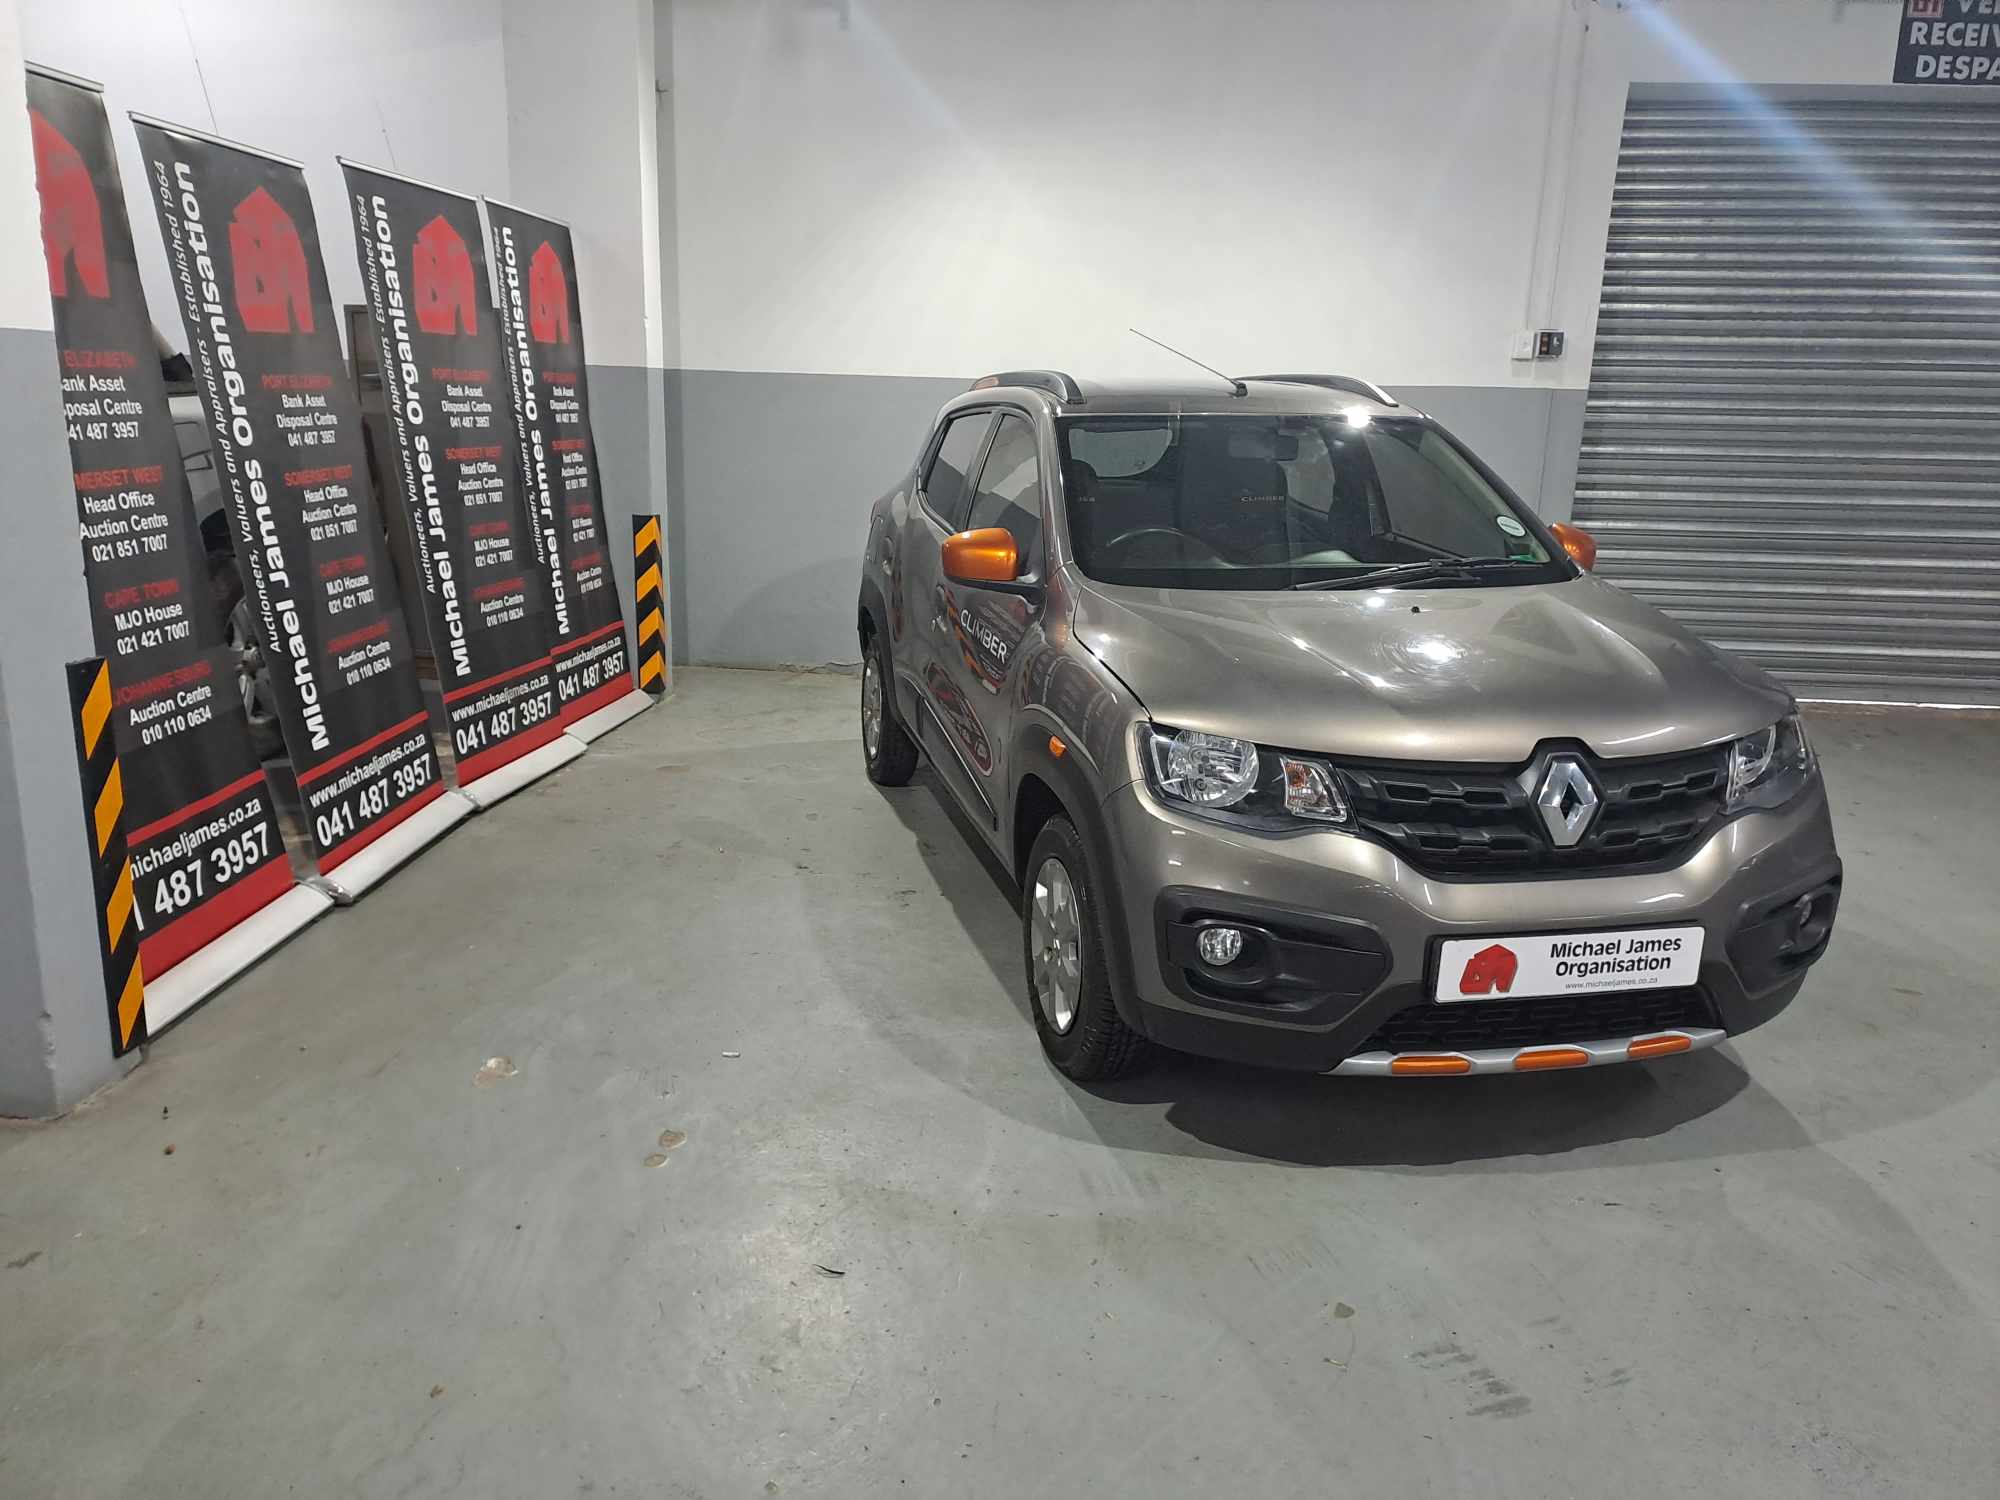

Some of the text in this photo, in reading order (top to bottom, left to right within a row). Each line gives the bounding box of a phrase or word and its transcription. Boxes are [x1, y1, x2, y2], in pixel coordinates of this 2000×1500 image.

[153, 160, 174, 209] 1964
[356, 194, 370, 234] 1964
[165, 213, 200, 323] Established
[362, 236, 385, 324] Established
[61, 375, 126, 391] ank Asset
[197, 338, 228, 435] Appraisers
[382, 336, 402, 415] Appraisers
[63, 398, 143, 420] posal Centre
[275, 413, 313, 429] Disposal
[281, 394, 327, 408] Bank Asset
[68, 421, 140, 441] 41 487 3957
[288, 433, 302, 447] 041
[304, 431, 318, 446] 487
[372, 195, 472, 677] Michael James Organisation
[394, 415, 408, 446] and
[502, 226, 570, 635] Michael James Organisation
[515, 414, 526, 439] and
[174, 161, 330, 751] Michael James Organisation
[218, 438, 237, 473] and
[401, 449, 418, 502] Valuers
[521, 441, 533, 487] Valuers
[75, 468, 130, 490] MERSET
[303, 485, 349, 503] Head Office
[83, 491, 156, 514] Head Office
[231, 478, 253, 543] Valuers
[301, 508, 333, 524] Auction
[79, 513, 169, 541] Auction Centre
[91, 533, 168, 562] 021 851 7007
[413, 508, 436, 594] Auctioneers,
[249, 549, 282, 653] Auctioneers,
[343, 575, 369, 590] House
[114, 603, 183, 631] MJO House
[960, 609, 1008, 665] CLIMBER
[117, 621, 190, 656] 021 421 7007
[555, 636, 621, 673] www.michaeljames.co.za
[338, 650, 367, 670] Auction
[558, 651, 624, 701] 041 487 3957
[129, 702, 176, 726] Auction
[176, 684, 212, 708] Centre
[452, 674, 549, 722] www.michaeljames.co.za
[141, 704, 213, 746] 010 110 0634
[456, 691, 552, 755] 041 487 3957
[309, 733, 426, 808] www.michaeljames.co.za
[316, 753, 432, 847] 041 487 3957
[129, 798, 262, 881] michaeljames.co.za
[154, 859, 204, 915] 487
[210, 821, 269, 884] 3957
[1550, 937, 1682, 958] Michael James
[1555, 955, 1672, 978] Organisation
[1565, 976, 1659, 990] www.michaeljames.co.za
